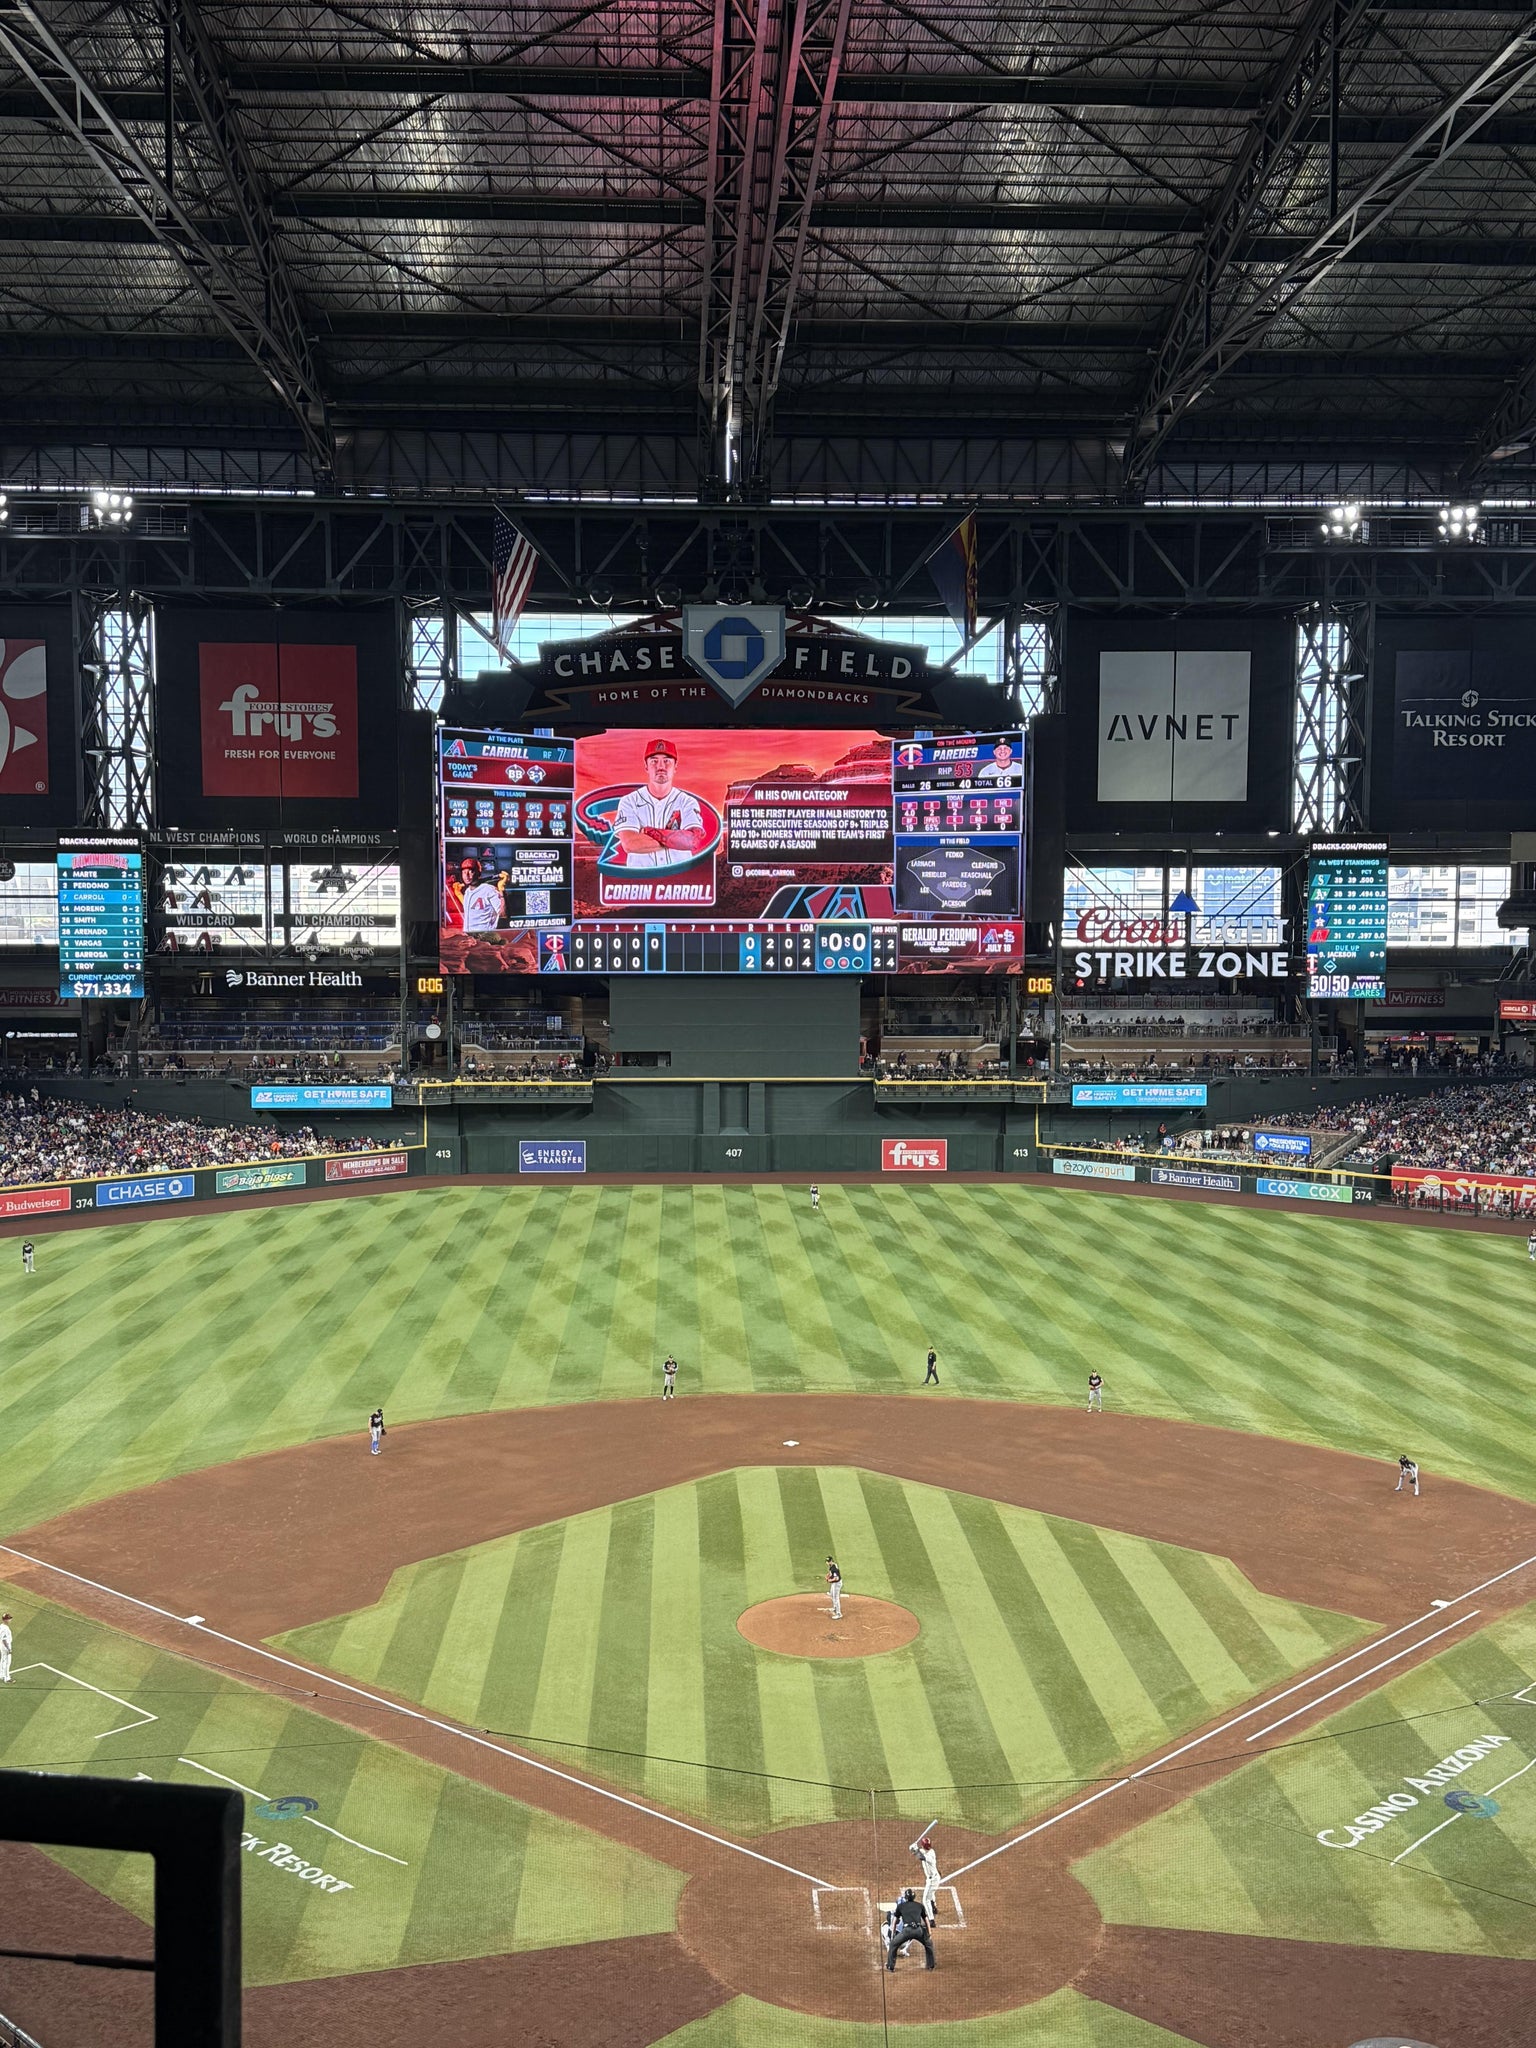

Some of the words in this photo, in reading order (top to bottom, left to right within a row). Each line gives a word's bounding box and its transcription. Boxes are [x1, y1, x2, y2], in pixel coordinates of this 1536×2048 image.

[554, 646, 674, 677] CHASE
[795, 647, 912, 679] FIELD
[598, 690, 640, 702] HOME
[651, 688, 668, 697] OF
[680, 687, 706, 697] THE
[762, 688, 869, 704] DIAMONDBACKS
[218, 684, 337, 742] fry's
[249, 703, 280, 711] FOOD
[286, 703, 329, 712] STORES
[1401, 710, 1481, 727] TALKING
[1487, 710, 1536, 727] STICK
[1107, 714, 1240, 742] AVNET
[1432, 729, 1506, 747] RESORT
[224, 749, 256, 759] FRESH
[259, 750, 280, 759] FOR
[284, 750, 336, 760] EVERYONE
[481, 745, 529, 759] CARROLL
[543, 750, 552, 759] RF
[557, 747, 567, 762] 7
[933, 747, 979, 761] PAREDES
[447, 762, 478, 772] TODAY'S
[938, 767, 953, 775] RHP
[954, 762, 973, 778] 53
[452, 771, 474, 779] GAME
[919, 781, 931, 791] 26
[959, 779, 971, 789] 40
[974, 779, 993, 787] TOTAL
[996, 776, 1012, 788] 66
[754, 790, 764, 800] IN
[765, 790, 779, 800] HIS
[780, 790, 801, 800] OWN
[802, 790, 849, 801] CATEGORY
[731, 809, 741, 819] HE
[742, 809, 750, 819] IS
[750, 809, 765, 819] THE
[766, 809, 786, 819] FIRST
[787, 809, 816, 819] PLAYER
[816, 809, 825, 819] IN
[826, 809, 842, 819] MLB
[843, 809, 876, 819] HISTORY
[876, 809, 887, 819] TO
[731, 819, 751, 829] HAVE
[752, 819, 803, 829] CONSECUTIVE
[803, 819, 837, 829] SEASONS
[838, 819, 849, 829] OF
[849, 819, 859, 829] 9+
[859, 819, 889, 829] TRIPLES
[149, 832, 163, 843] NL
[165, 832, 195, 843] WEST
[200, 832, 261, 843] CHAMPIONS
[283, 833, 319, 844] WORLD
[321, 834, 381, 845] CHAMPIONS
[731, 829, 747, 839] AND
[747, 829, 760, 839] 10+
[761, 829, 793, 839] HOMERS
[794, 829, 821, 839] WITHIN
[821, 829, 836, 839] THE
[836, 829, 865, 839] TEAM'S
[865, 829, 885, 839] FIRST
[59, 837, 139, 846] DBACKS.COM/PROMOS
[731, 839, 740, 849] 75
[741, 839, 767, 849] GAMES
[768, 839, 778, 849] OF
[779, 839, 786, 849] A
[786, 839, 817, 849] SEASON
[511, 866, 563, 875] STREAM
[511, 874, 541, 883] D-BACKS
[541, 874, 563, 882] GAMES
[604, 884, 653, 900] CORBIN
[655, 884, 713, 901] CARROLL
[176, 915, 204, 926] WILD
[206, 915, 235, 926] CARD
[294, 915, 310, 926] NL
[311, 915, 376, 927] CHAMPIONS
[1075, 906, 1181, 944] Coors
[1189, 918, 1290, 944] LIGHT
[74, 928, 108, 936] ARENADO
[748, 923, 754, 932] R
[767, 923, 774, 932] H
[786, 923, 791, 932] E
[800, 923, 814, 932] LOB
[902, 927, 938, 942] GERALDO
[940, 927, 978, 942] PERDOMO
[745, 938, 755, 950] 0
[766, 938, 775, 950] 2
[785, 938, 793, 950] 0
[802, 938, 811, 950] 2
[821, 936, 828, 948] B
[829, 933, 843, 952] 0
[844, 936, 850, 948] S
[852, 933, 866, 952] 0
[985, 944, 1001, 953] JULY
[75, 962, 95, 970] TROY
[1075, 951, 1186, 978] STRIKE
[1198, 951, 1289, 978] ZONE
[245, 971, 306, 987] Banner
[308, 971, 363, 987] Health
[73, 980, 132, 998] $71,334
[418, 977, 443, 994] 0:06
[1027, 977, 1053, 994] 0:06
[1351, 981, 1385, 990] AVNET
[1354, 989, 1380, 997] CARES
[9, 994, 52, 1004] FITNESS
[1405, 995, 1444, 1004] FITNESS
[303, 1090, 326, 1099] GET
[359, 1090, 387, 1099] SAFE
[1122, 1088, 1143, 1097] GET
[1175, 1088, 1203, 1097] SAFE
[435, 1149, 451, 1159] 413
[537, 1149, 573, 1158] ENERGY
[725, 1148, 742, 1158] 407
[888, 1142, 940, 1168] fry's
[1013, 1148, 1029, 1157] 413
[342, 1158, 381, 1170] MEMBERSHIPS
[383, 1158, 390, 1166] ON
[390, 1156, 405, 1165] SALE
[537, 1156, 583, 1165] TRANSFER
[351, 1168, 364, 1176] TEXT
[239, 1173, 263, 1186] Baja
[264, 1171, 293, 1183] Blast
[1168, 1173, 1202, 1185] Banner
[1203, 1174, 1235, 1189] Health
[108, 1182, 165, 1200] CHASE
[1268, 1182, 1299, 1196] COX
[1309, 1185, 1341, 1199] COX
[1354, 1190, 1372, 1201] 374
[6, 1198, 62, 1212] Budweiser
[75, 1198, 94, 1209] 374
[1316, 1792, 1419, 1849] CASINO
[1403, 1734, 1512, 1795] ARIZONA
[257, 1842, 355, 1894] RESORT
